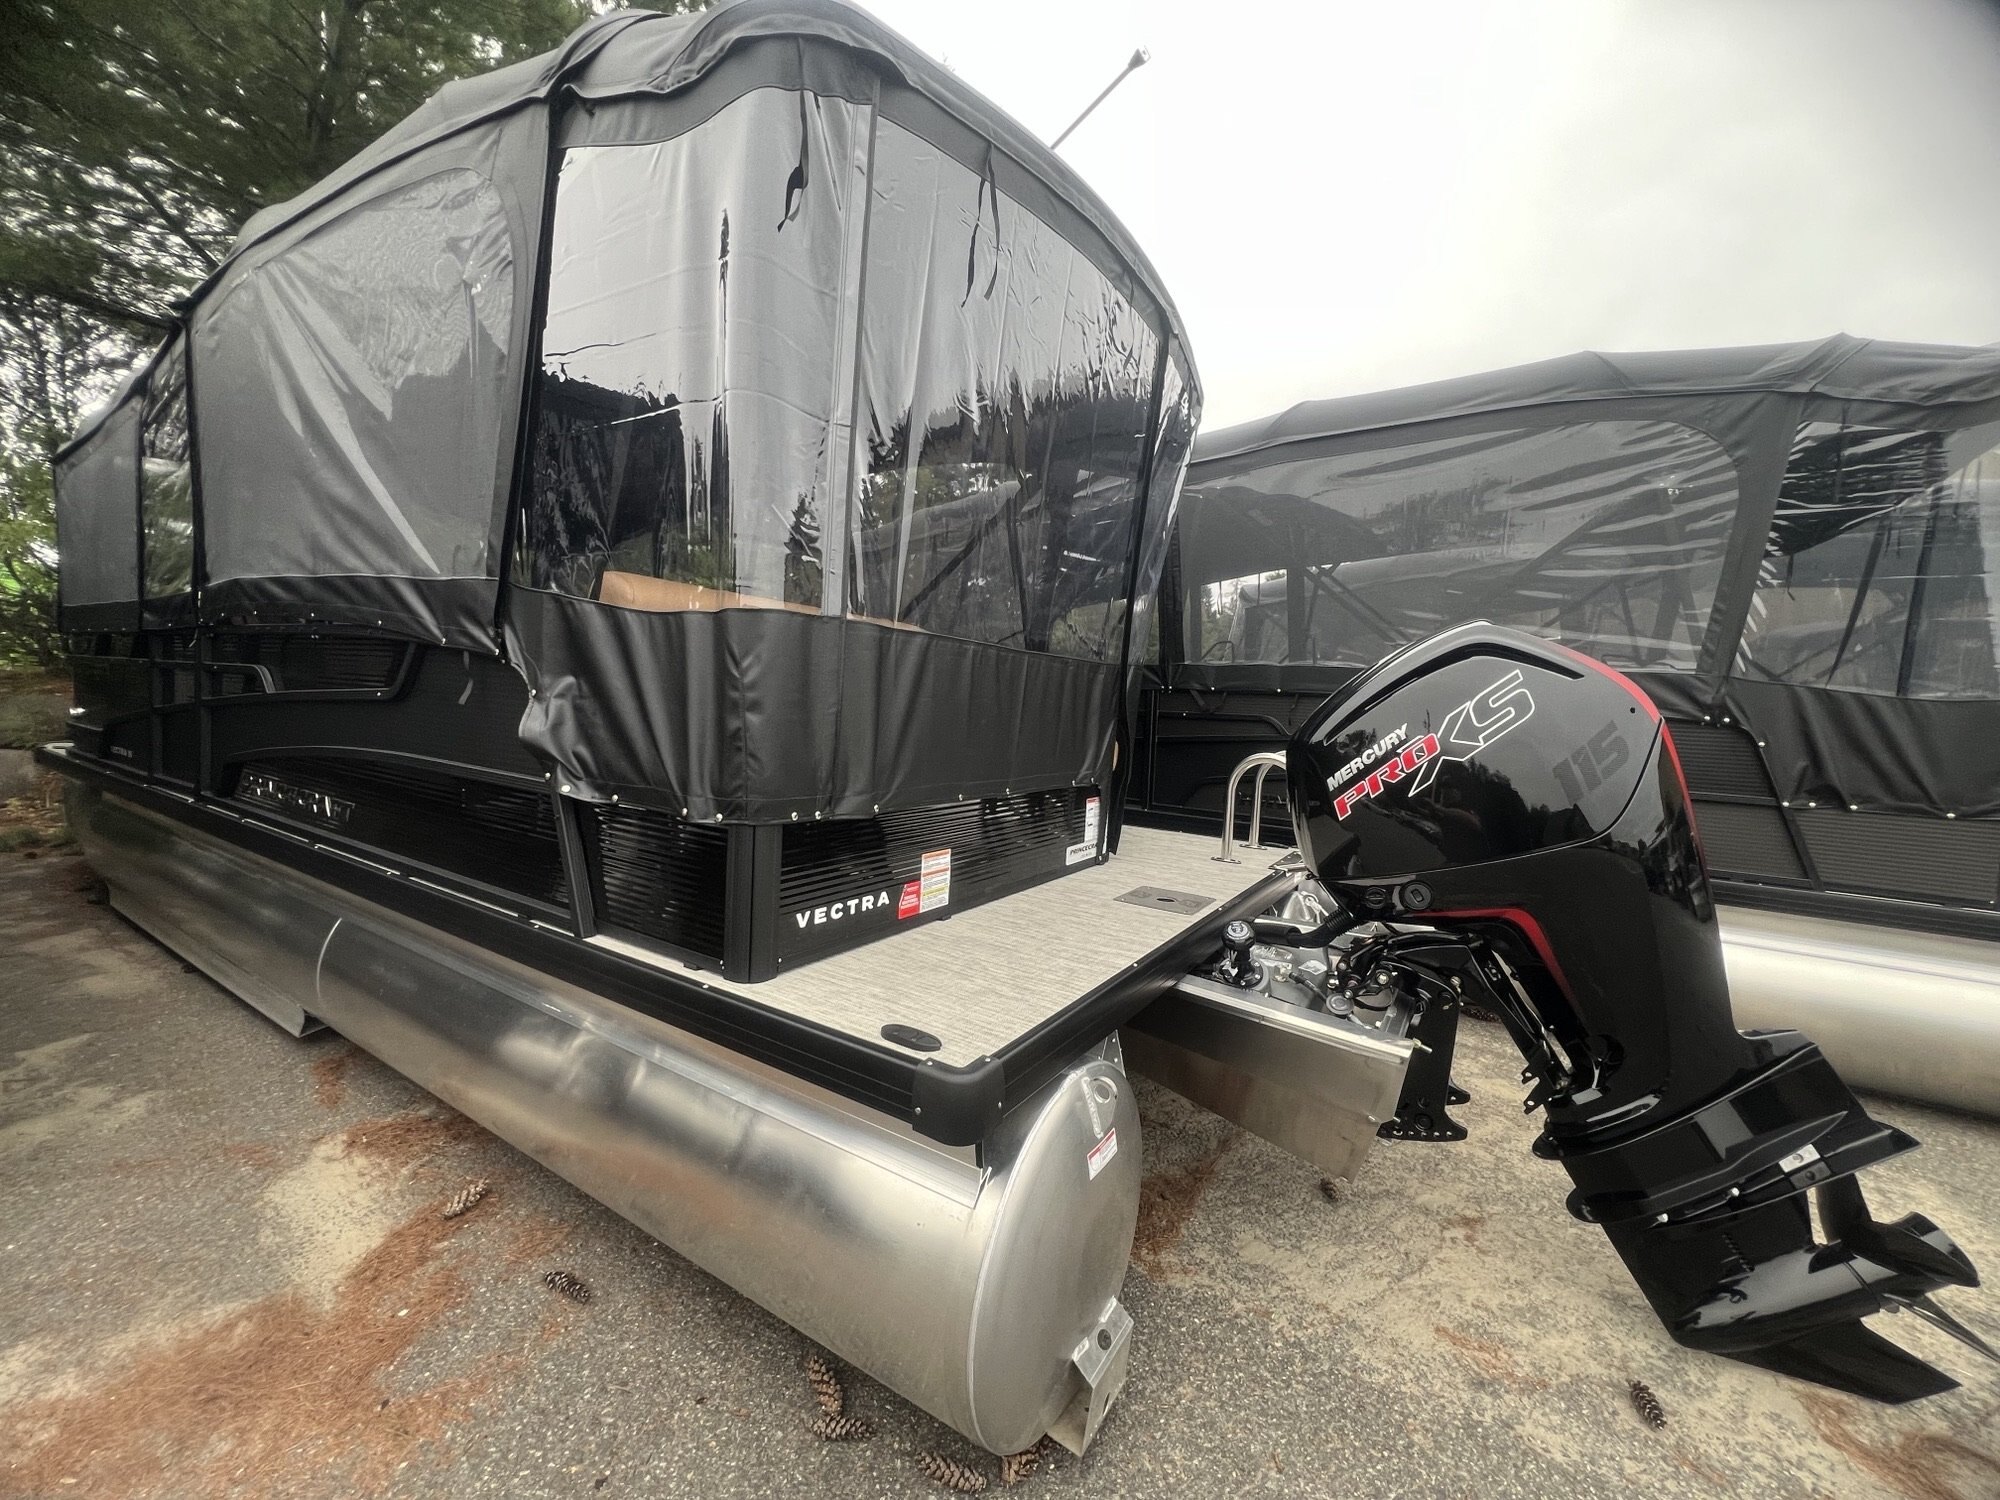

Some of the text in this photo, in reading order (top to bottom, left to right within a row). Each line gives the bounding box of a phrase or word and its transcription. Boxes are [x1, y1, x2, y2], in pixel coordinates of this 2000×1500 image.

[1326, 723, 1408, 792] MERCURY
[1333, 669, 1535, 821] PRO XS
[1552, 720, 1629, 807] 115
[795, 891, 890, 928] VECTRA
